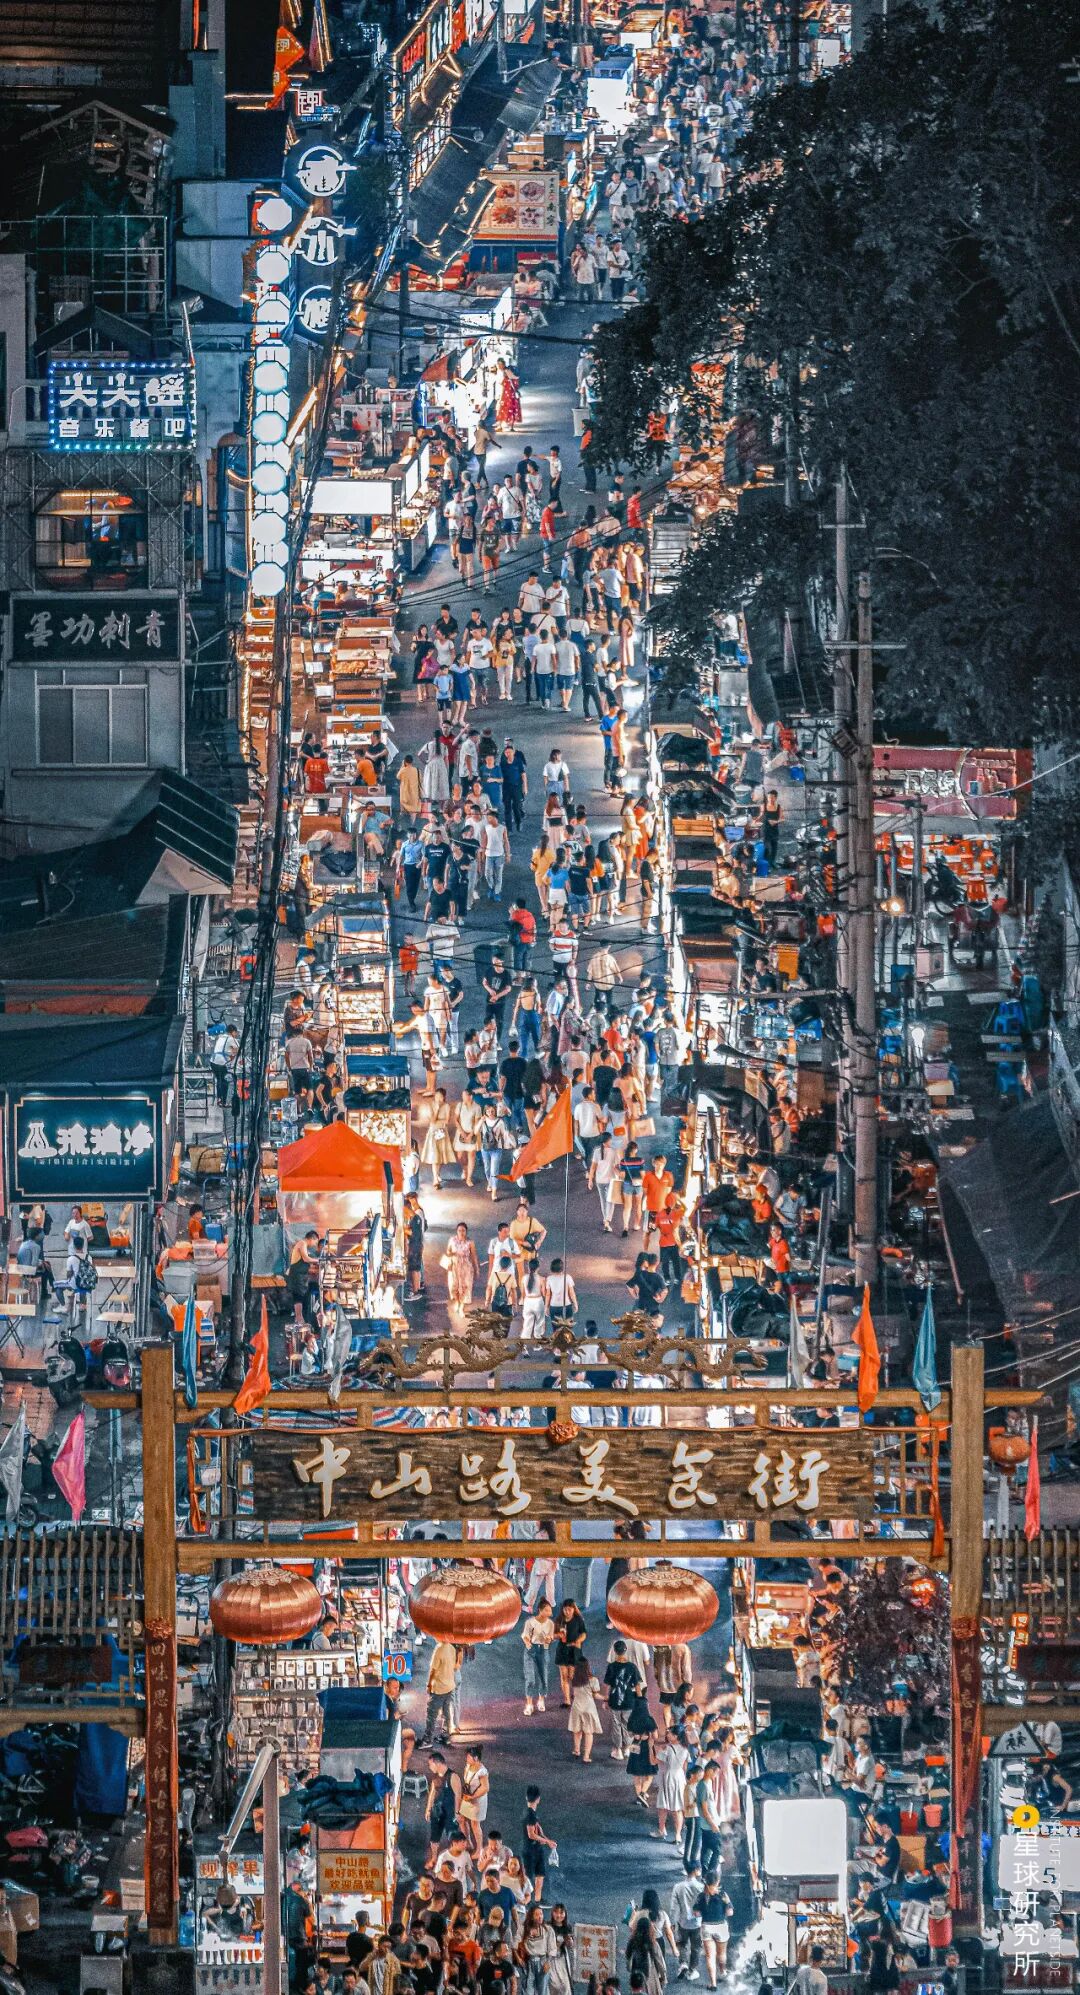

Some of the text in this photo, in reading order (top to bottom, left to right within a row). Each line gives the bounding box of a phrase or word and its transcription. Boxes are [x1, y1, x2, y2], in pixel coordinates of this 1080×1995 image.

[59, 418, 185, 438] 音乐餐吧
[292, 1436, 830, 1518] 中山路美食街
[384, 1655, 407, 1677] 10
